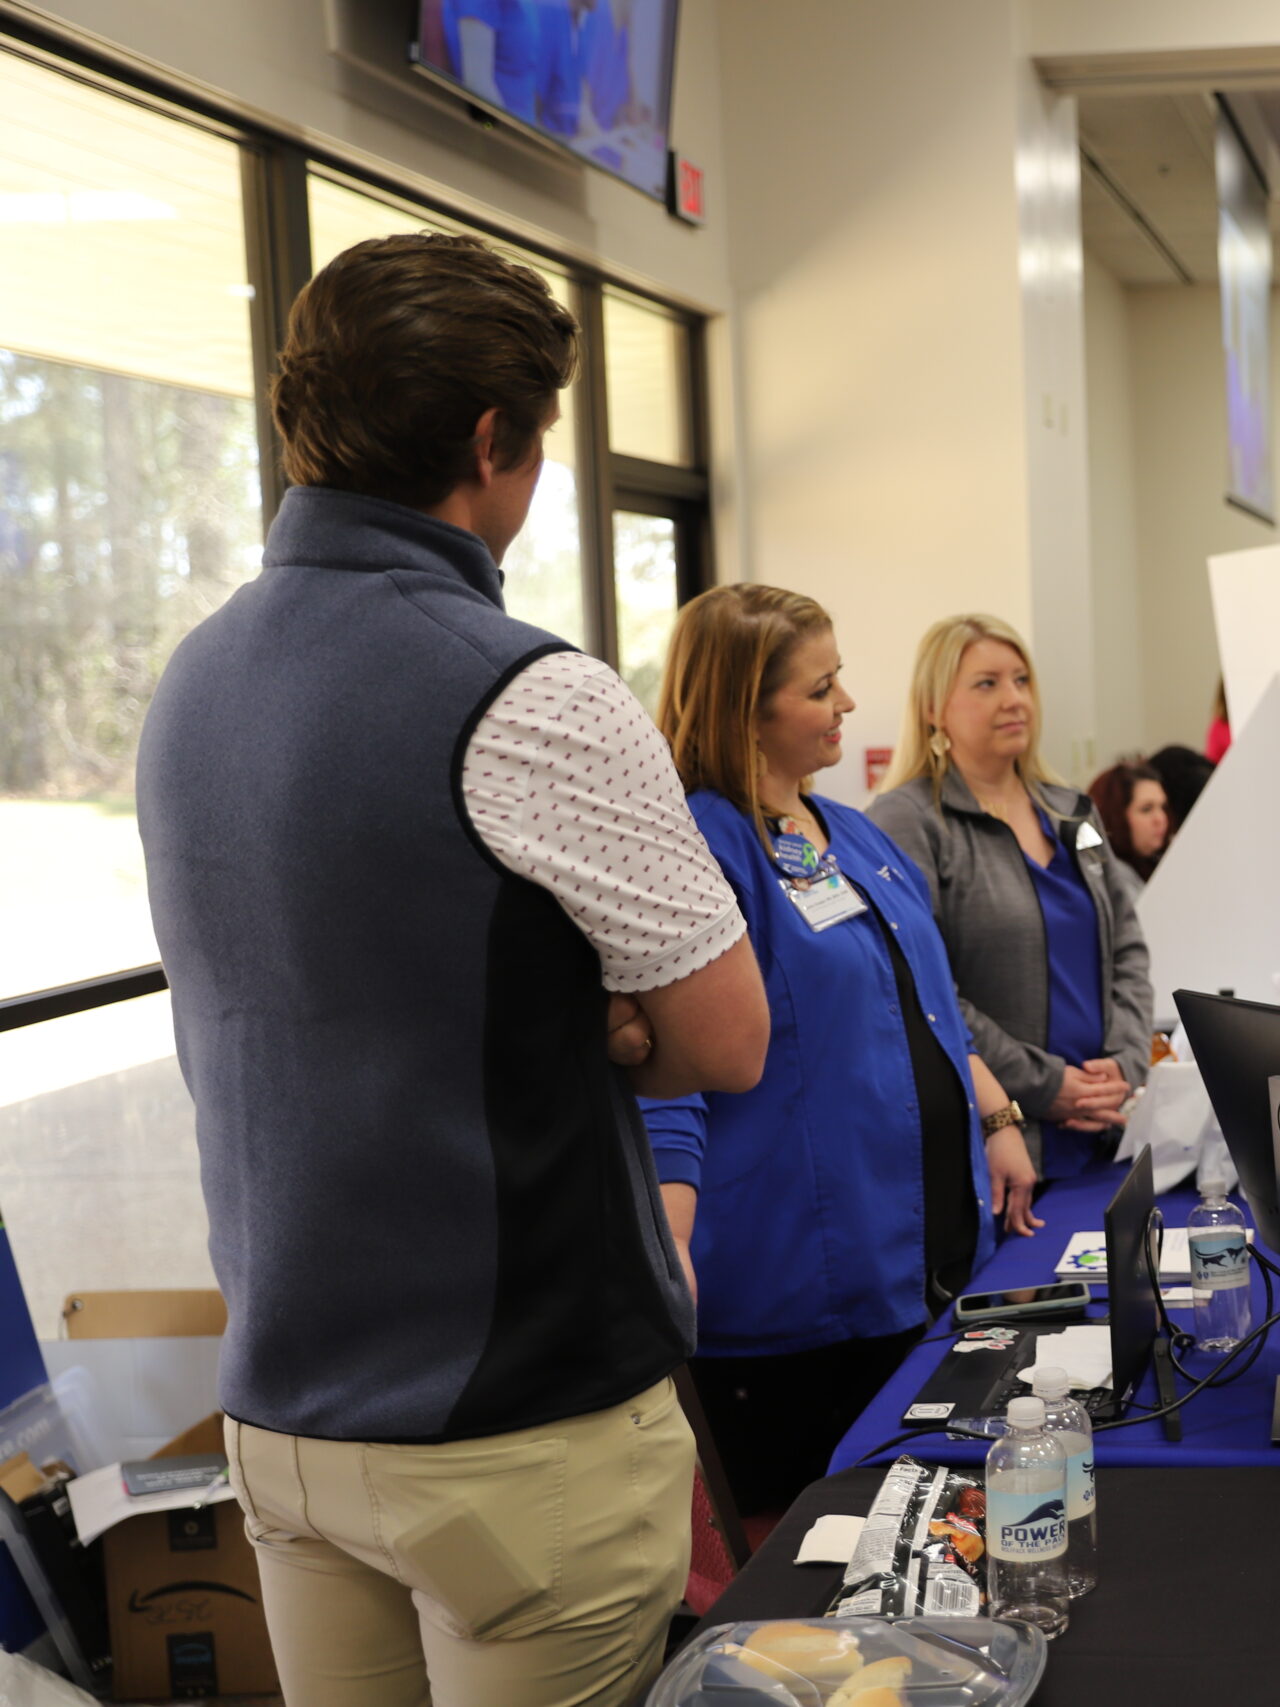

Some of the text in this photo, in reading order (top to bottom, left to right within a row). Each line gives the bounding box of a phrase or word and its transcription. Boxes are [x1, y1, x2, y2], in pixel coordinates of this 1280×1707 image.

[1001, 1519, 1065, 1542] POWER
[1001, 1539, 1014, 1548] OF
[1018, 1540, 1041, 1548] THE
